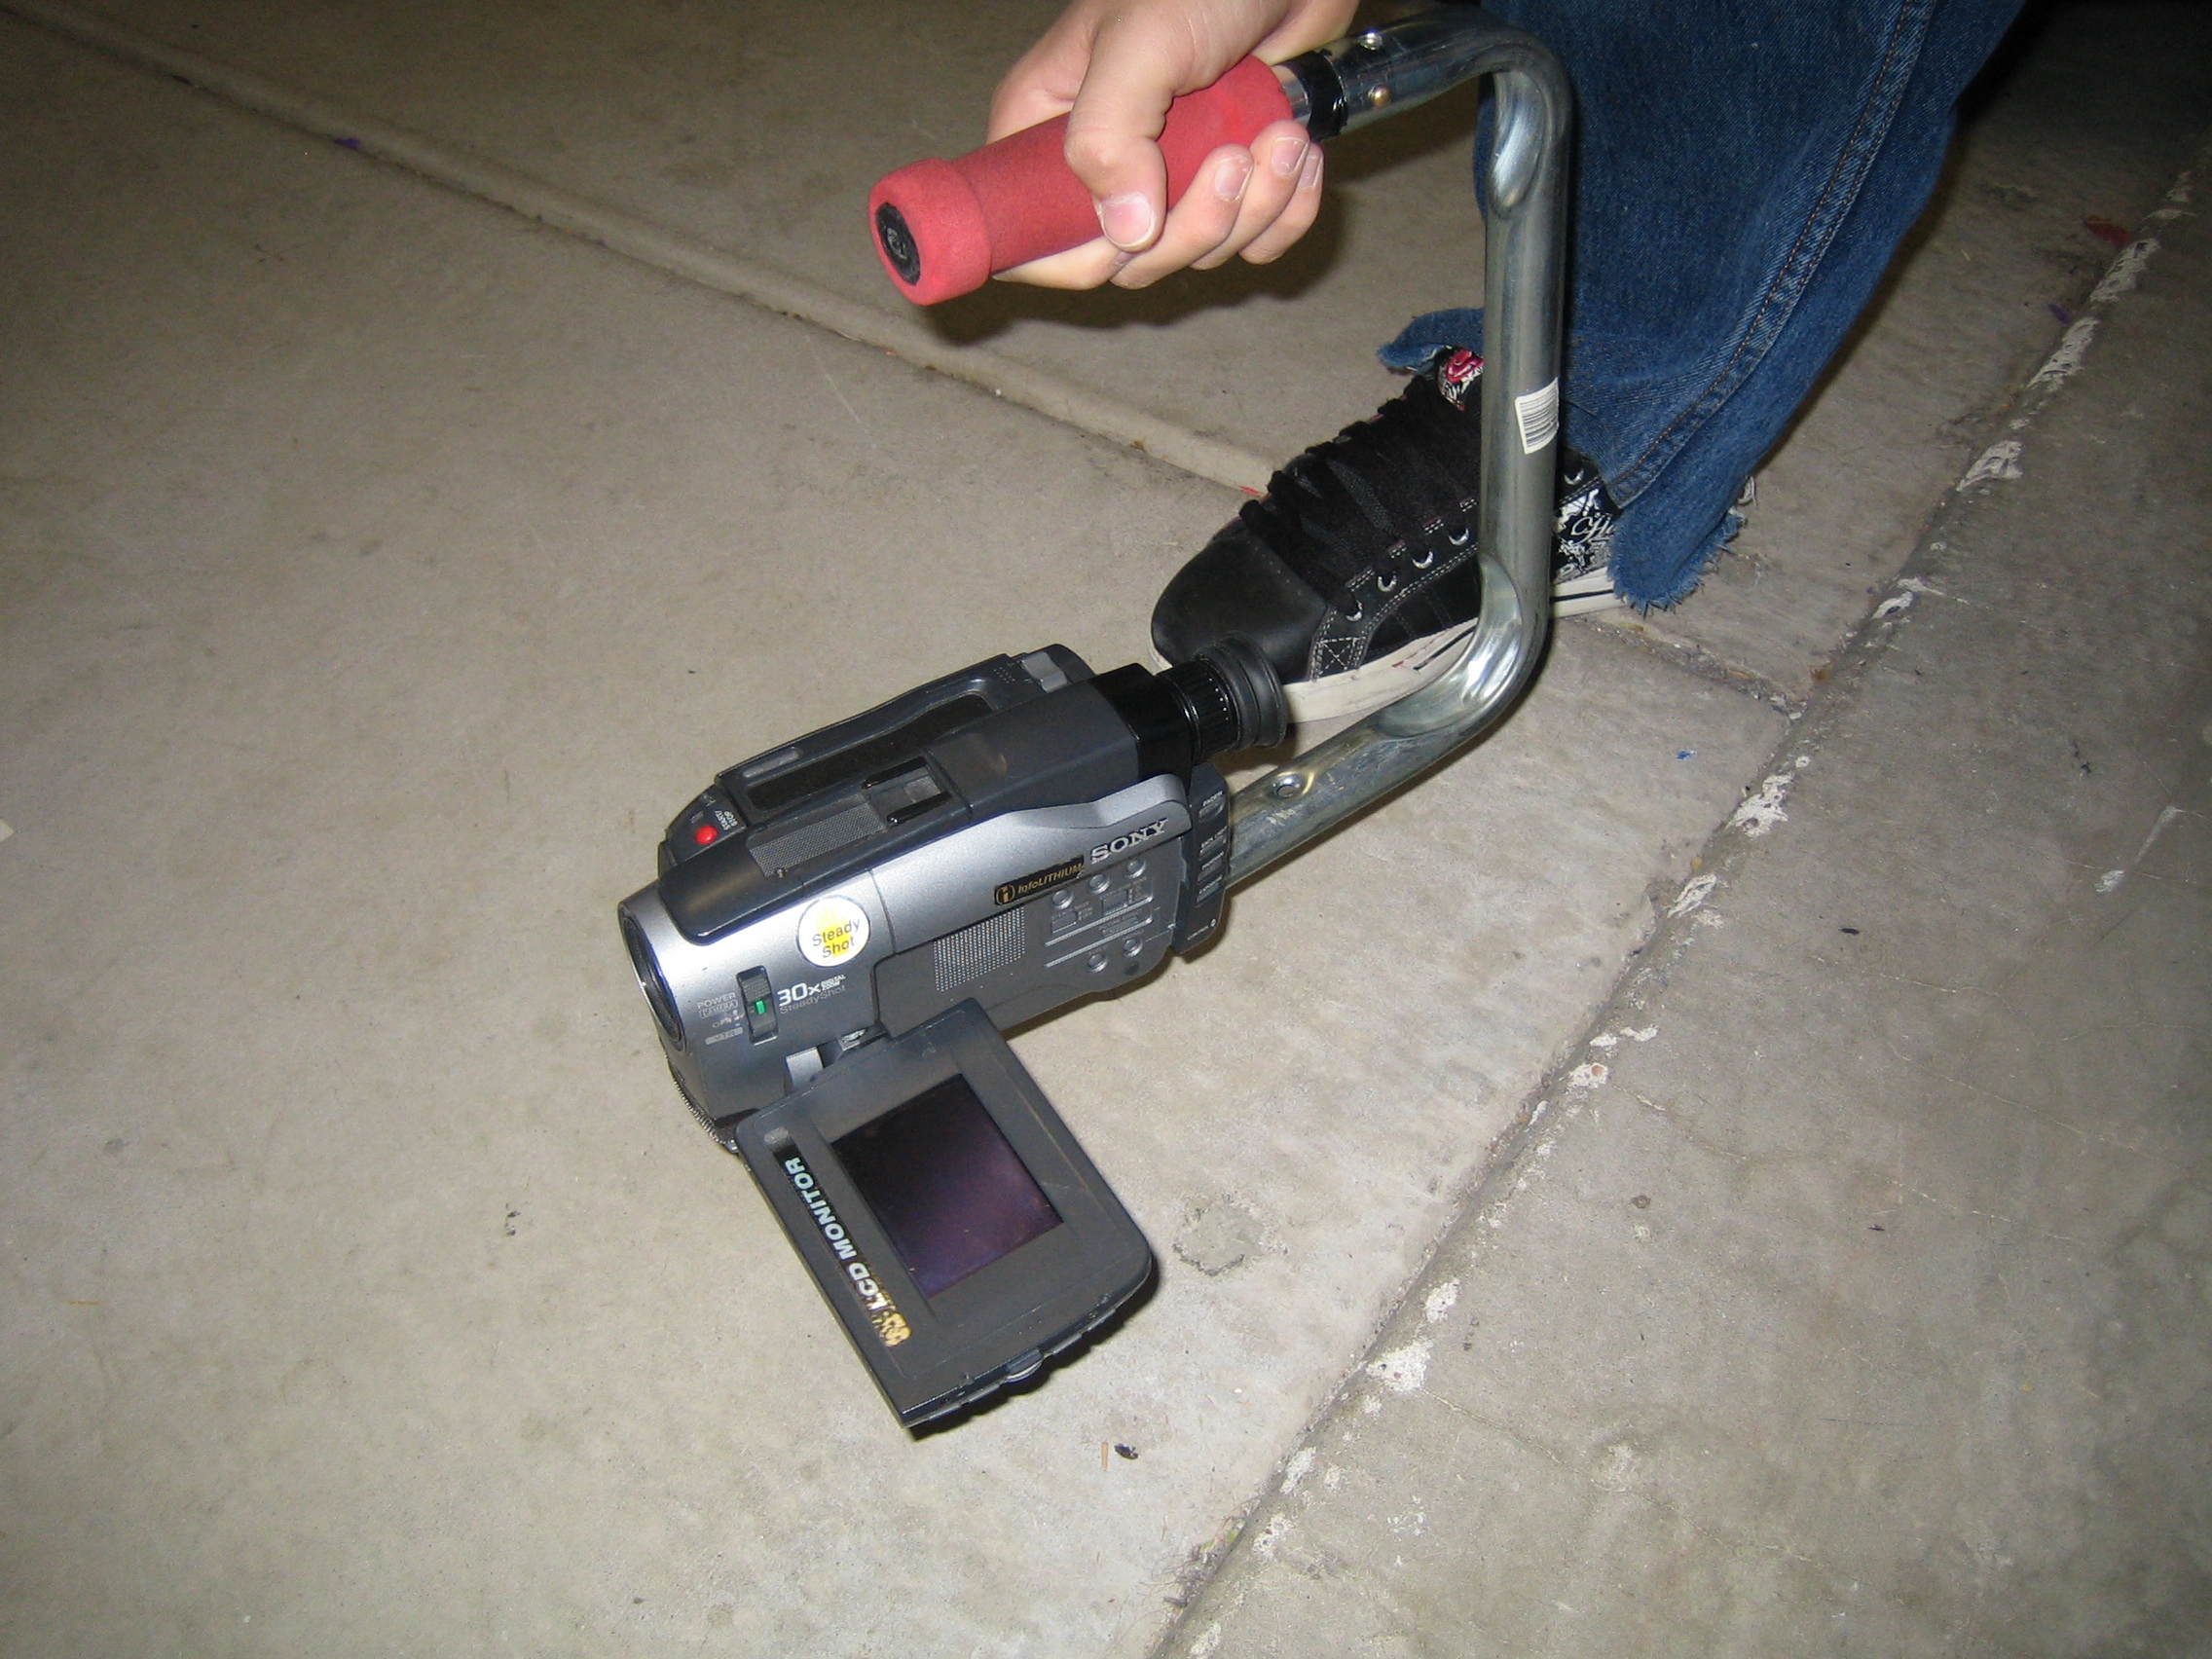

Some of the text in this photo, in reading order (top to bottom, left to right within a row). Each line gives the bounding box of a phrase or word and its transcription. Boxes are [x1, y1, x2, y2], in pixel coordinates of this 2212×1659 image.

[1090, 818, 1168, 865] SONY
[812, 918, 860, 946] Steady
[823, 935, 855, 958] Shot
[697, 992, 736, 1010] POWER
[785, 1157, 889, 1310] LCD MONITOR
